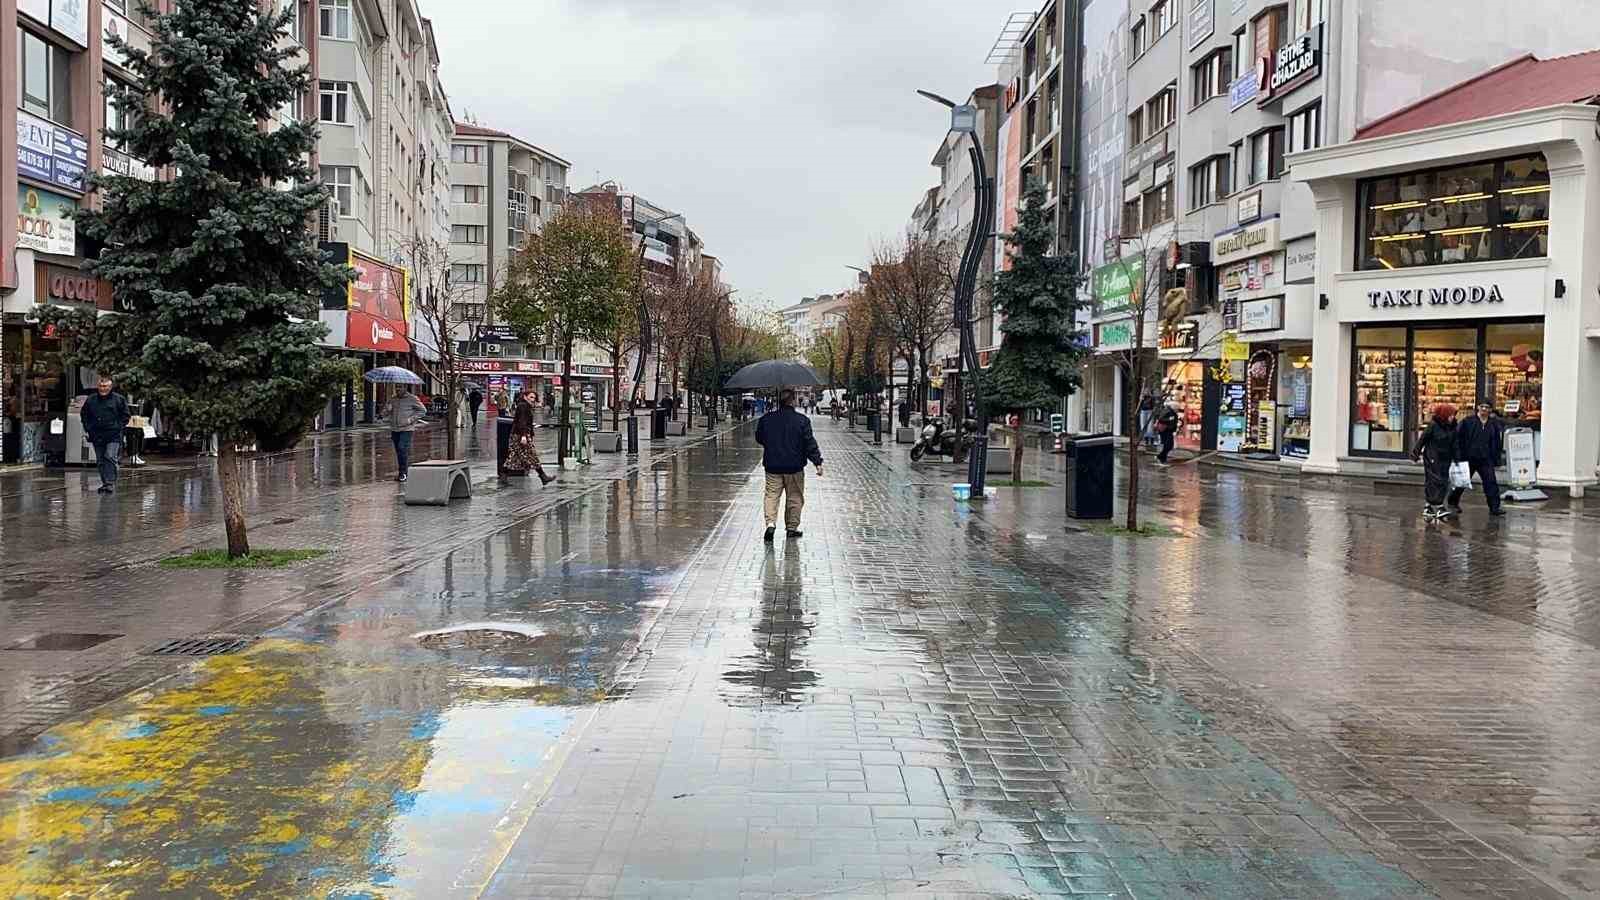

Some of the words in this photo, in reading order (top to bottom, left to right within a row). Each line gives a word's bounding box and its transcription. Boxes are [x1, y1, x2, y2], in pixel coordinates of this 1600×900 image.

[1271, 51, 1313, 89] CİHAZLARI
[1367, 289, 1422, 308] TAKI
[1428, 284, 1504, 305] MODA
